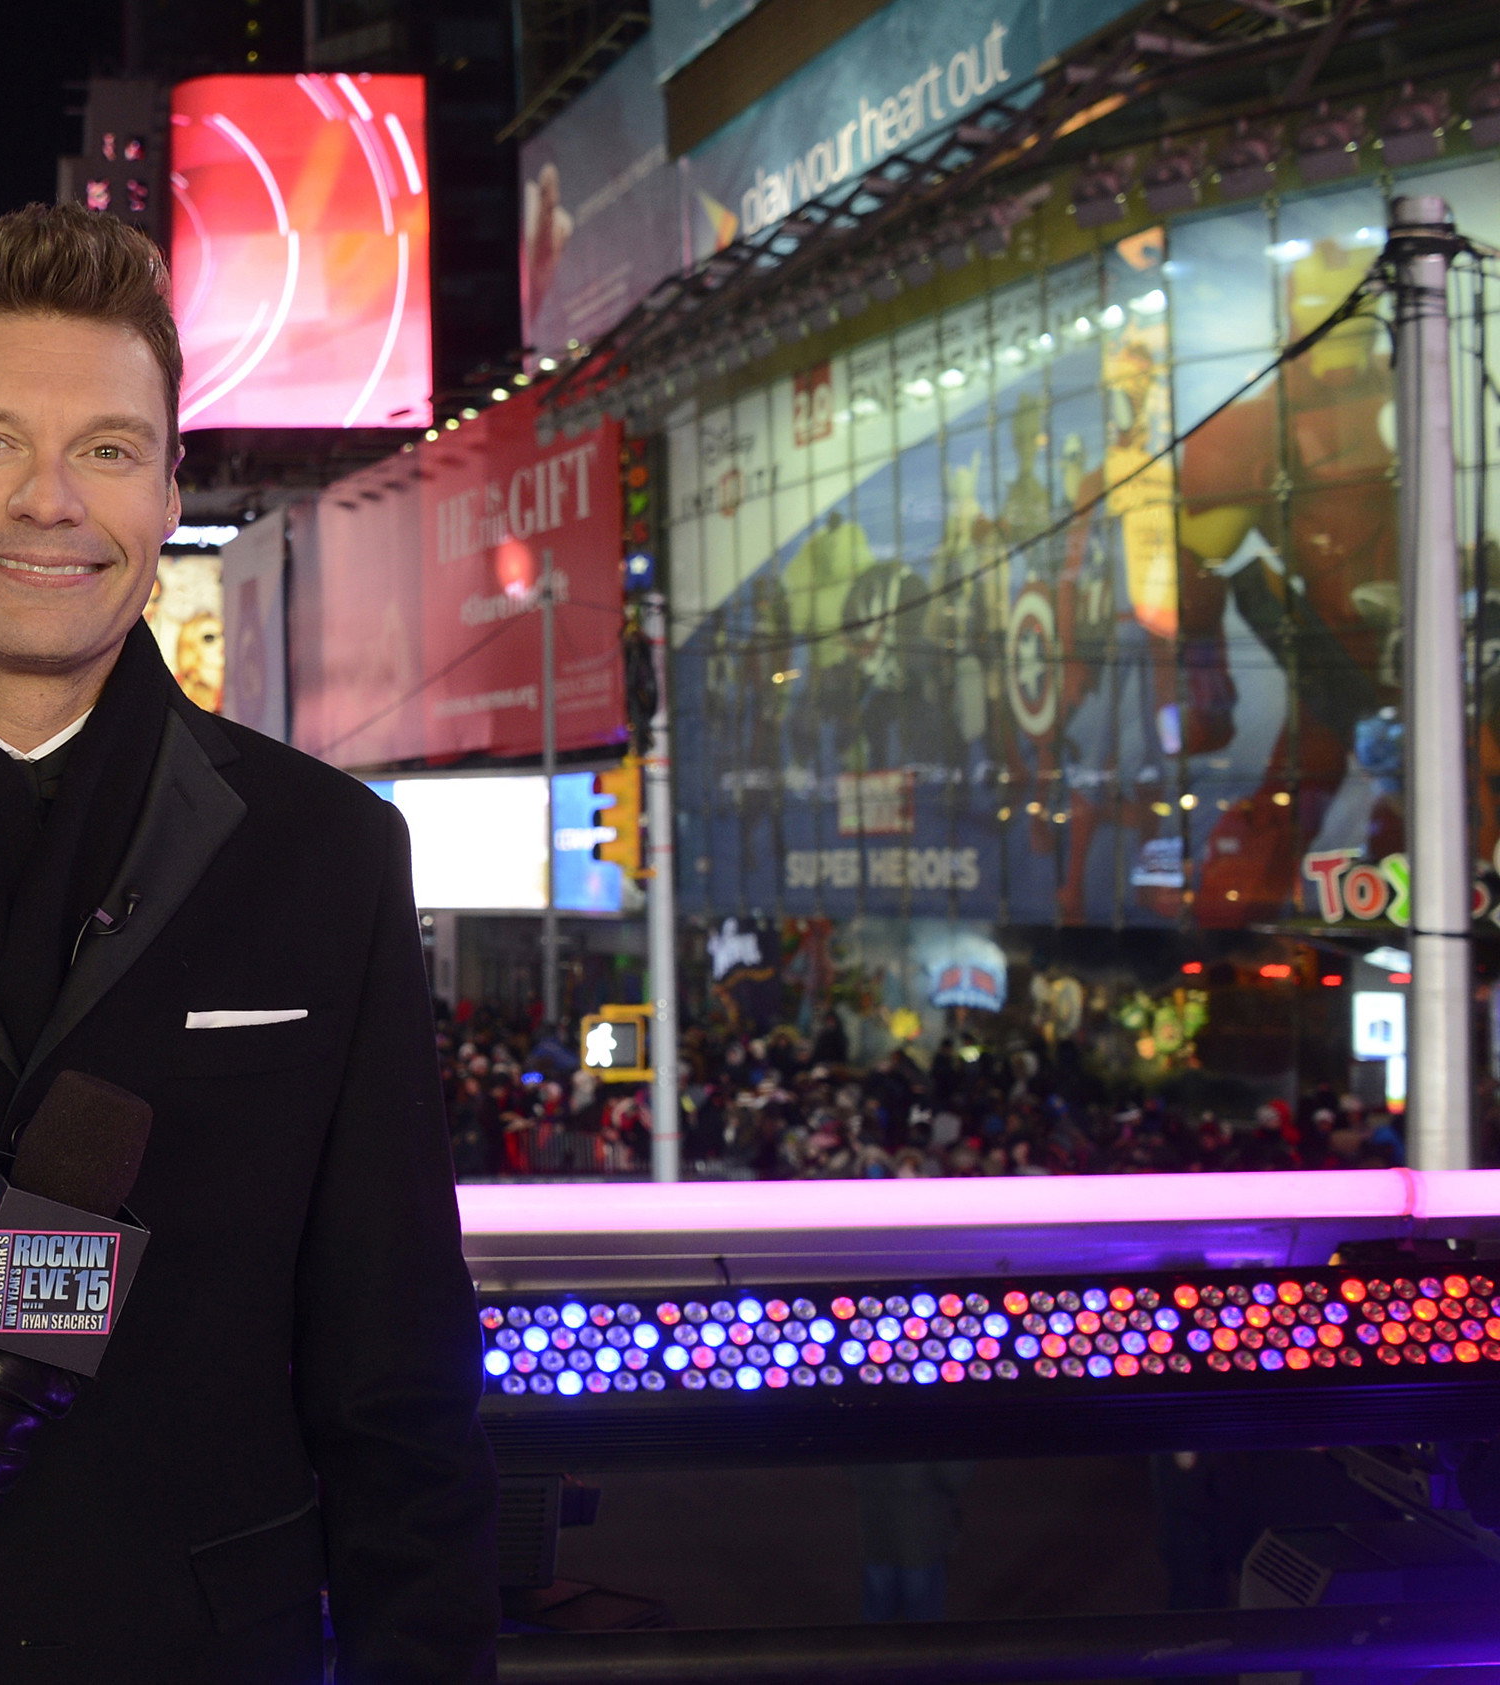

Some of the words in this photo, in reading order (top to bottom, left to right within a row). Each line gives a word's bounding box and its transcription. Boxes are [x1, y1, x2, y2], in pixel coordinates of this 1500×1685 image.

[859, 61, 945, 163] heart
[947, 20, 1011, 108] out
[508, 443, 598, 541] GIFT
[786, 850, 862, 888] SUPER
[868, 847, 979, 890] HEROES
[12, 1235, 115, 1268] ROCKIN'
[22, 1268, 71, 1300] EVE
[4, 1304, 18, 1327] NEW
[21, 1314, 49, 1329] RYAN
[51, 1314, 105, 1330] SEACREST
[22, 1302, 44, 1310] WITH
